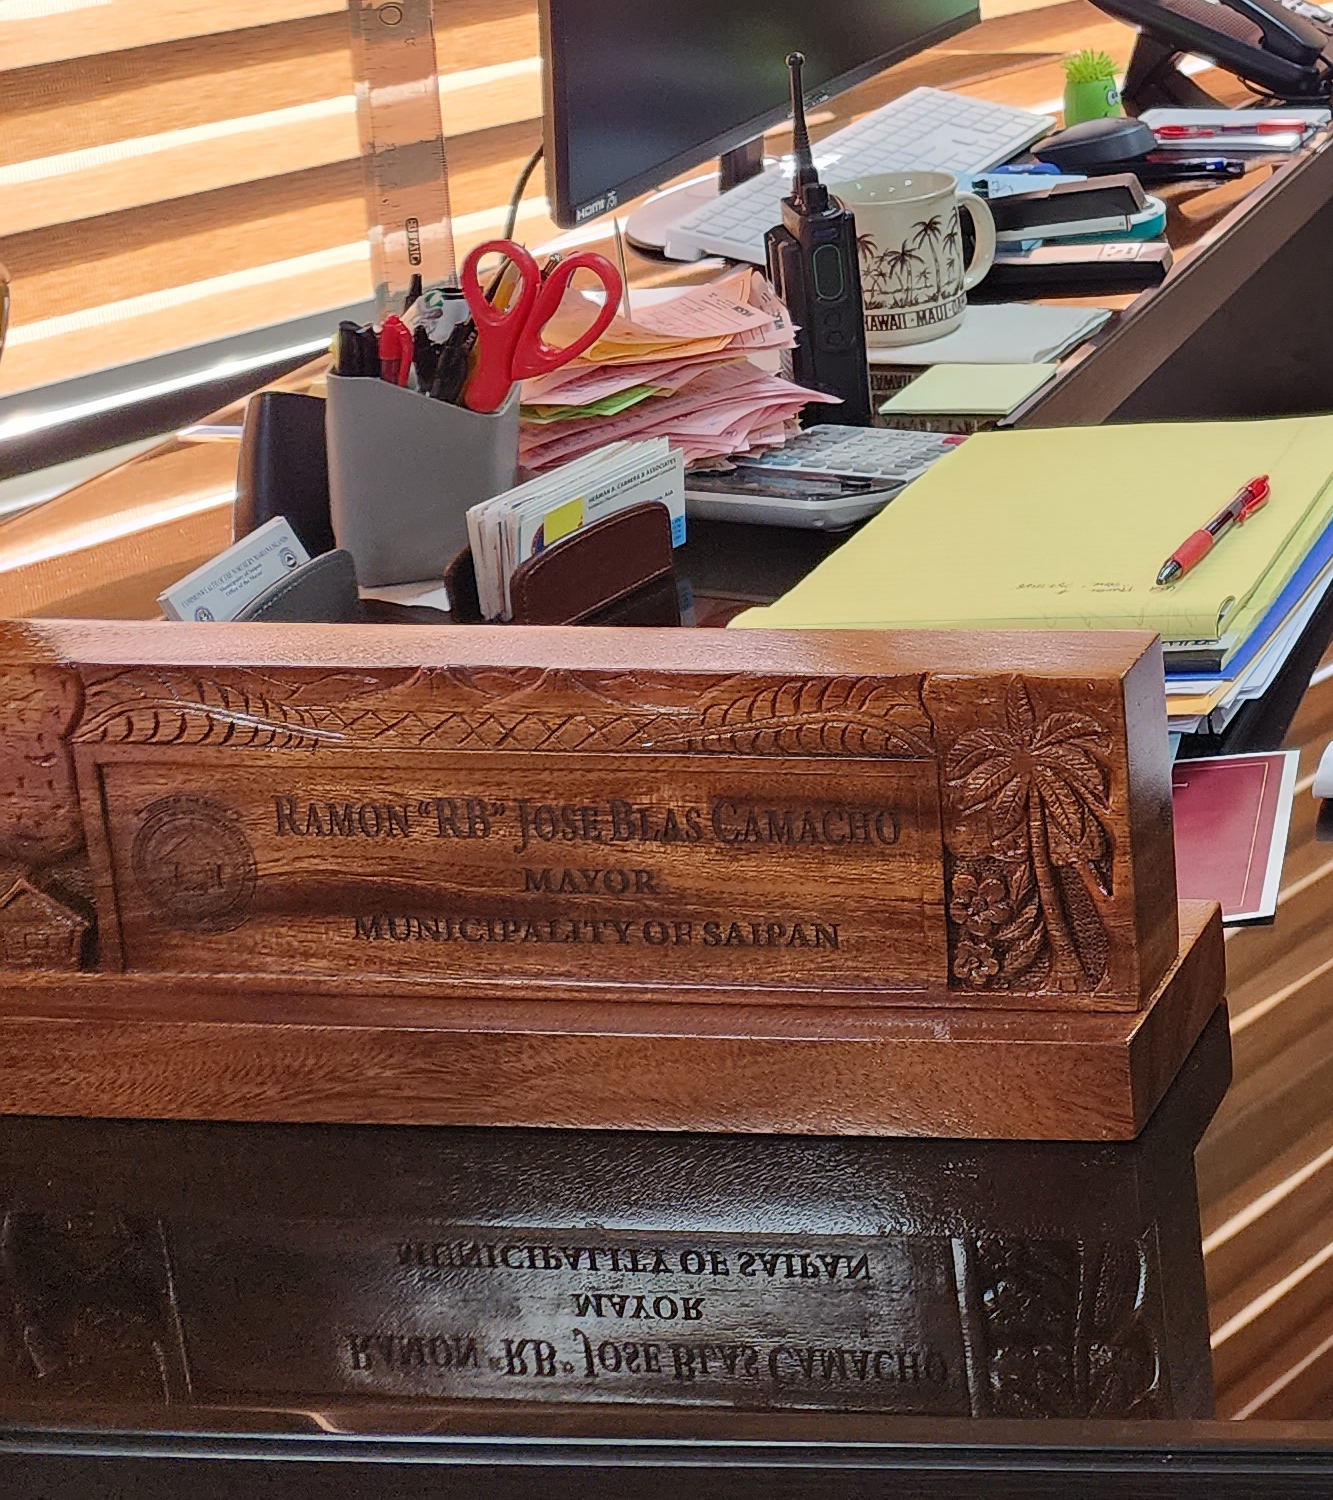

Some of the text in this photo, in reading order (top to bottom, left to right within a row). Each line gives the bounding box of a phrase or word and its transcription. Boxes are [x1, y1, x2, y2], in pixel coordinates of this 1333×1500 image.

[916, 303, 947, 327] MAUI
[275, 800, 410, 839] RAMON
[514, 800, 604, 853] JOSE
[607, 802, 700, 844] BLAS
[711, 802, 901, 847] CAMACHO
[522, 867, 661, 896] MAYOR
[351, 914, 841, 951] MUNICIPALITY OF SAIPAN
